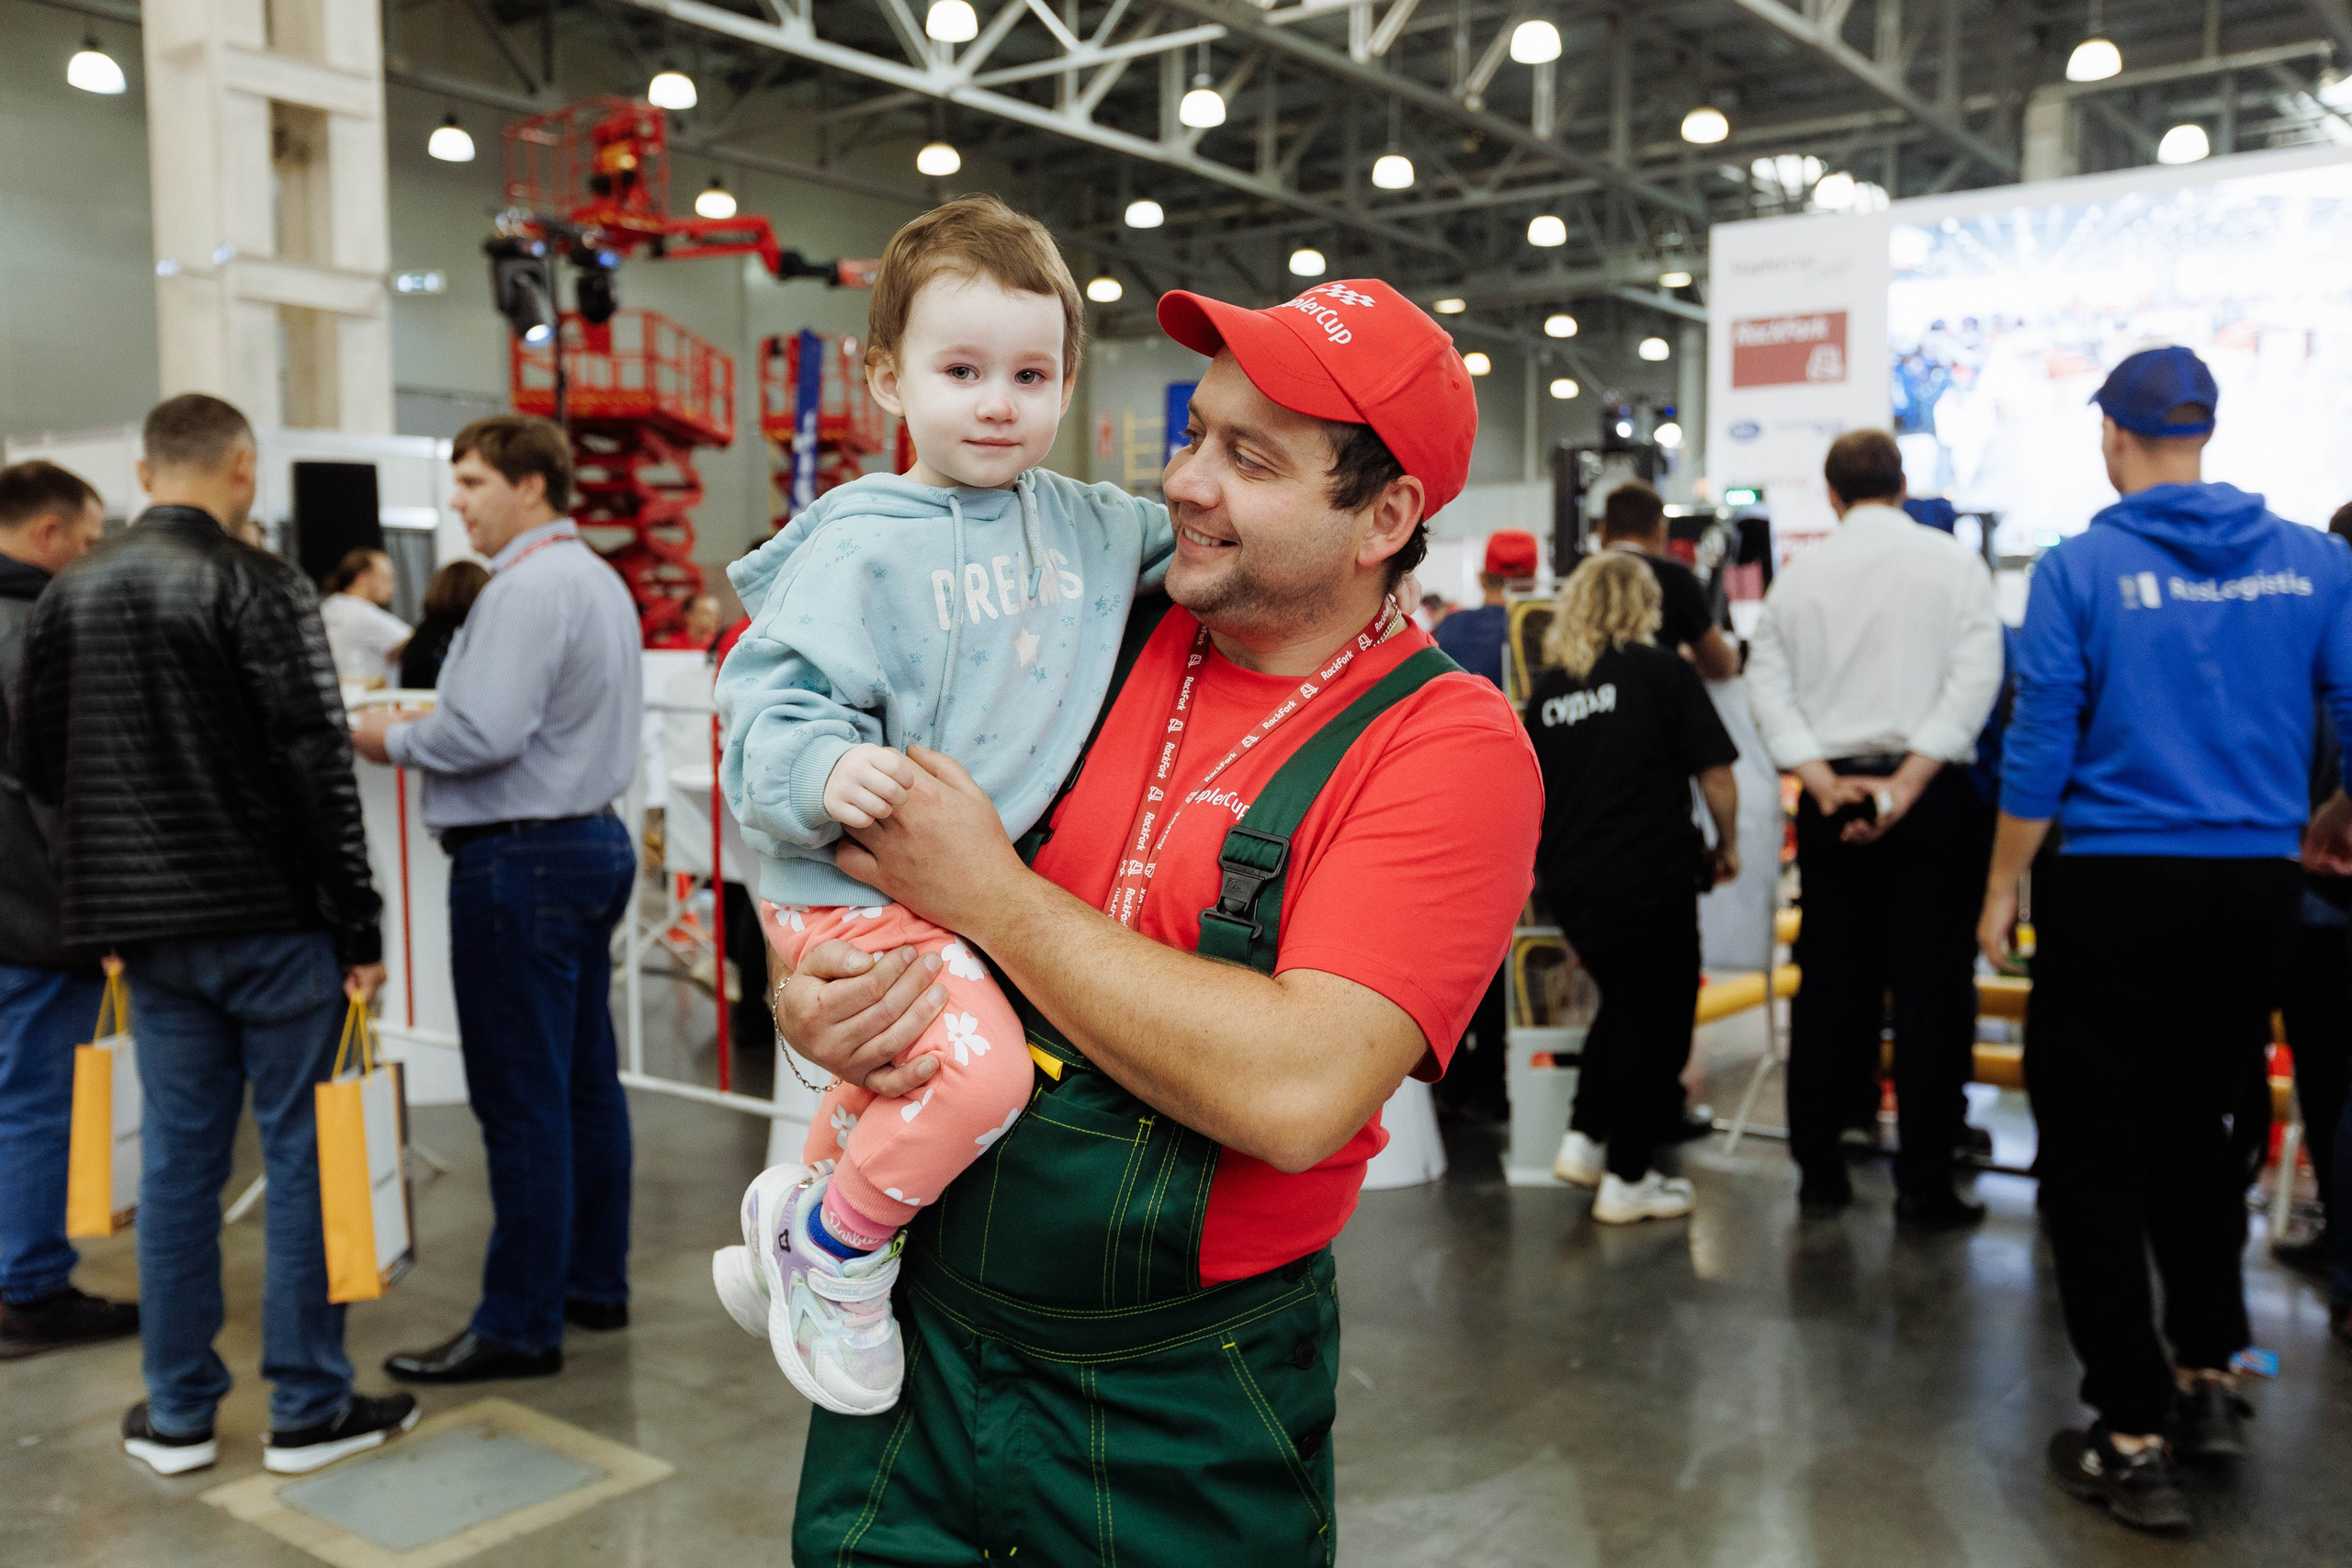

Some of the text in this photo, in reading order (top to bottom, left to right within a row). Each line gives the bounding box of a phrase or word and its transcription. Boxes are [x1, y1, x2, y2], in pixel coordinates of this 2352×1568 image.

[1320, 650, 1354, 682] RackFork
[1177, 676, 1194, 711] RackFork
[1262, 700, 1297, 730] RackFork
[1157, 741, 1176, 780] RackFork
[1204, 751, 1238, 783] RackFork
[1136, 811, 1155, 851] RackFork
[1157, 811, 1181, 851] RackFork
[1119, 887, 1136, 927] RackFor
